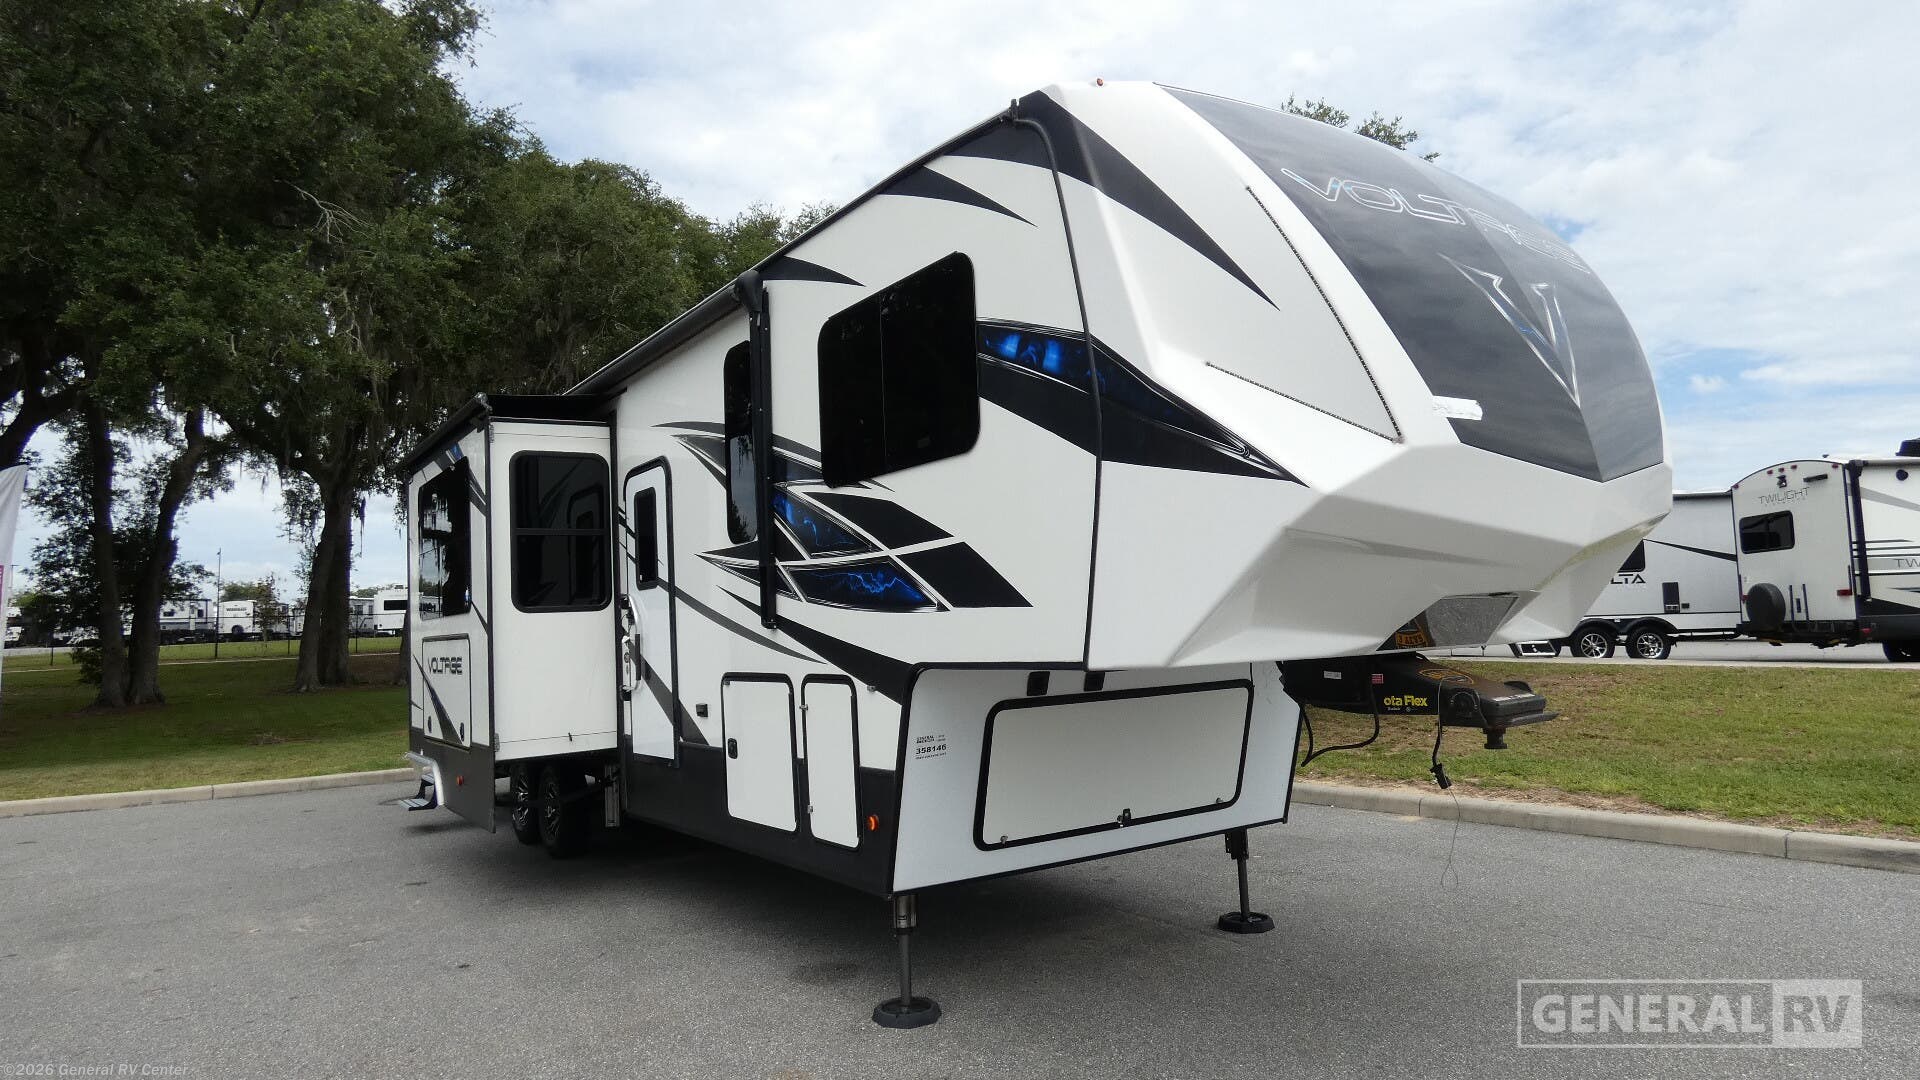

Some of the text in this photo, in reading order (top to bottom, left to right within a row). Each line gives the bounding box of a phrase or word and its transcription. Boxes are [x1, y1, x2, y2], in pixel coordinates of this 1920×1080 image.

[1758, 486, 1810, 504] TWILIGHT
[428, 656, 462, 674] VOLTAGE
[1404, 694, 1428, 707] Flex
[916, 744, 947, 755] 358146
